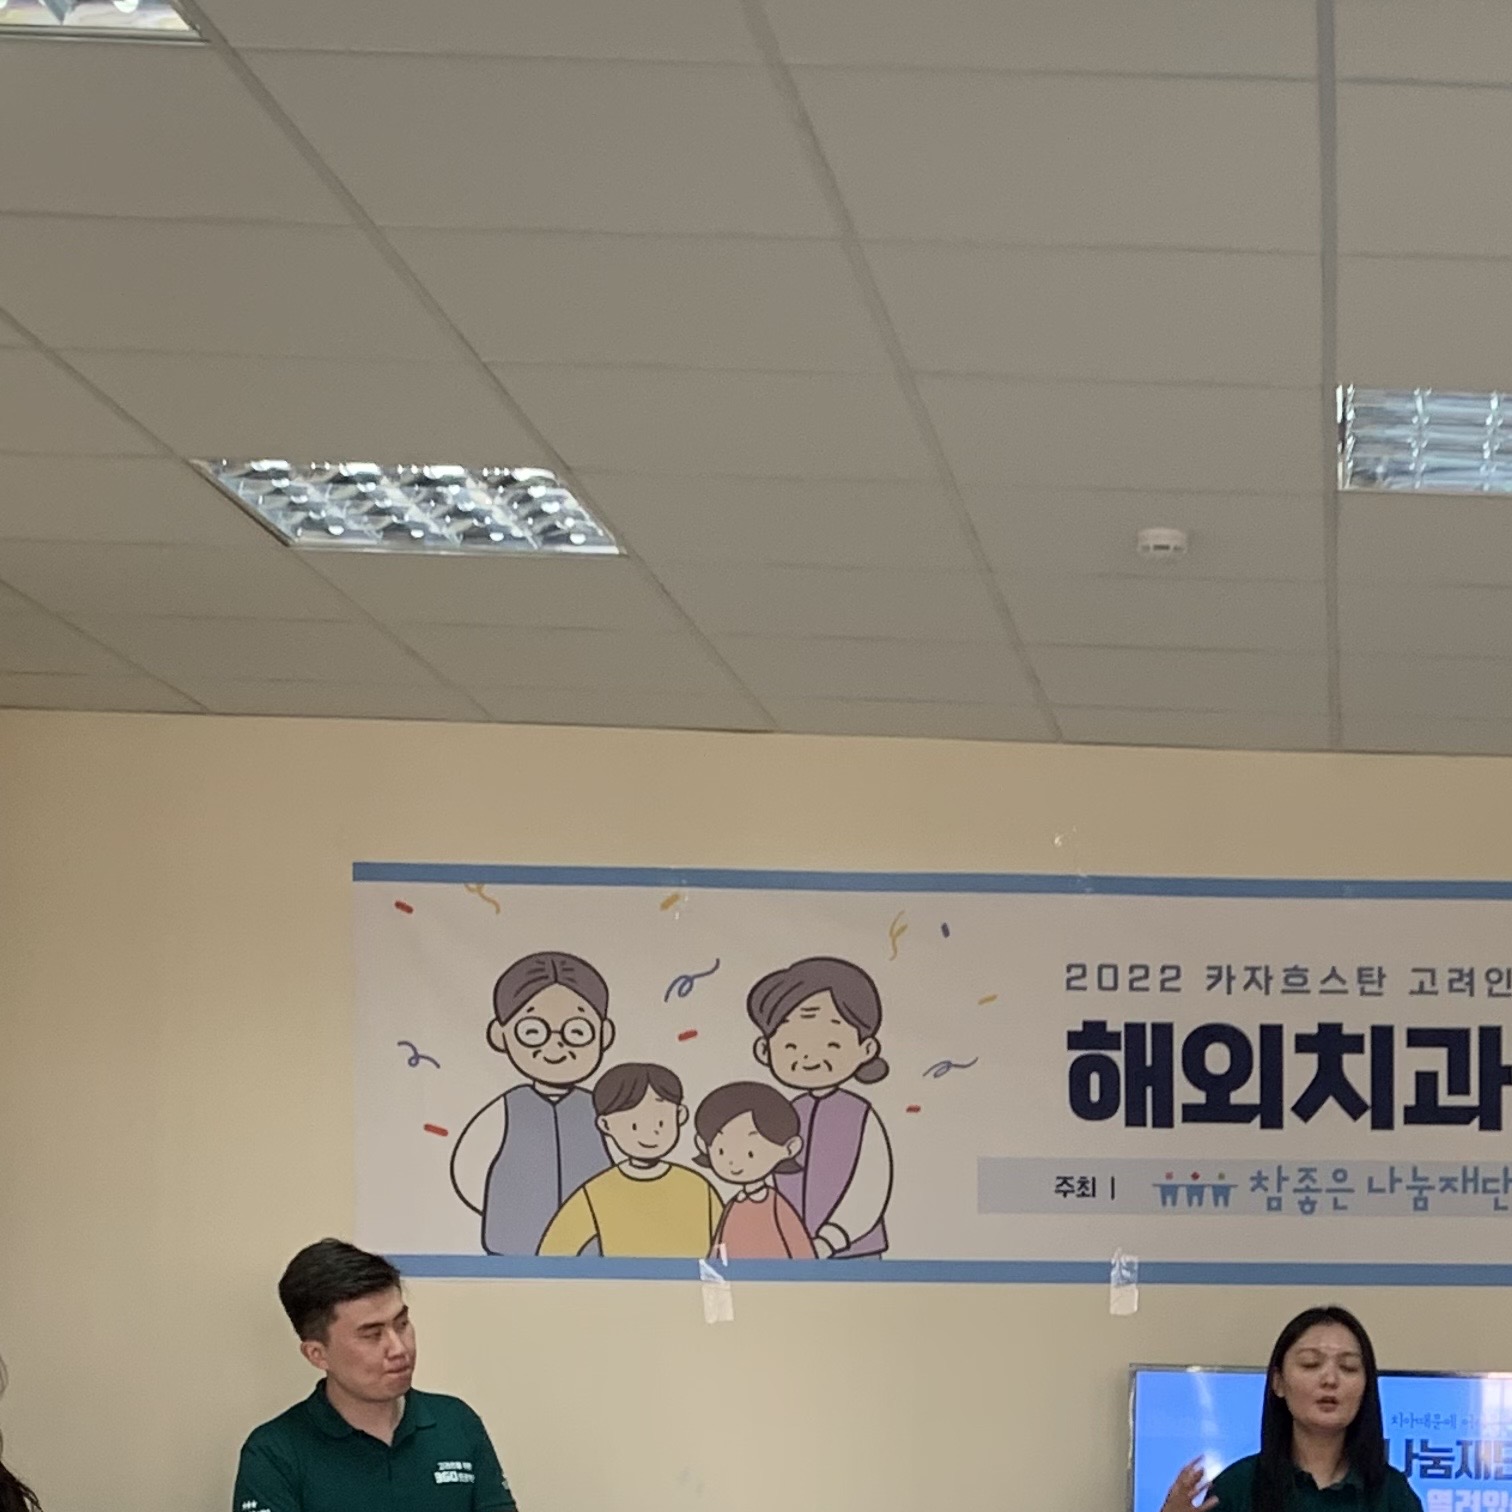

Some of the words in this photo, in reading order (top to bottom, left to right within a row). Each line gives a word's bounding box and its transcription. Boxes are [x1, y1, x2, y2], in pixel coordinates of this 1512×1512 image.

[1064, 962, 1183, 993] 2022
[1205, 963, 1387, 997] 카자흐스탄
[1053, 1175, 1097, 1199] 주최
[1248, 1164, 1356, 1216] 참좋은
